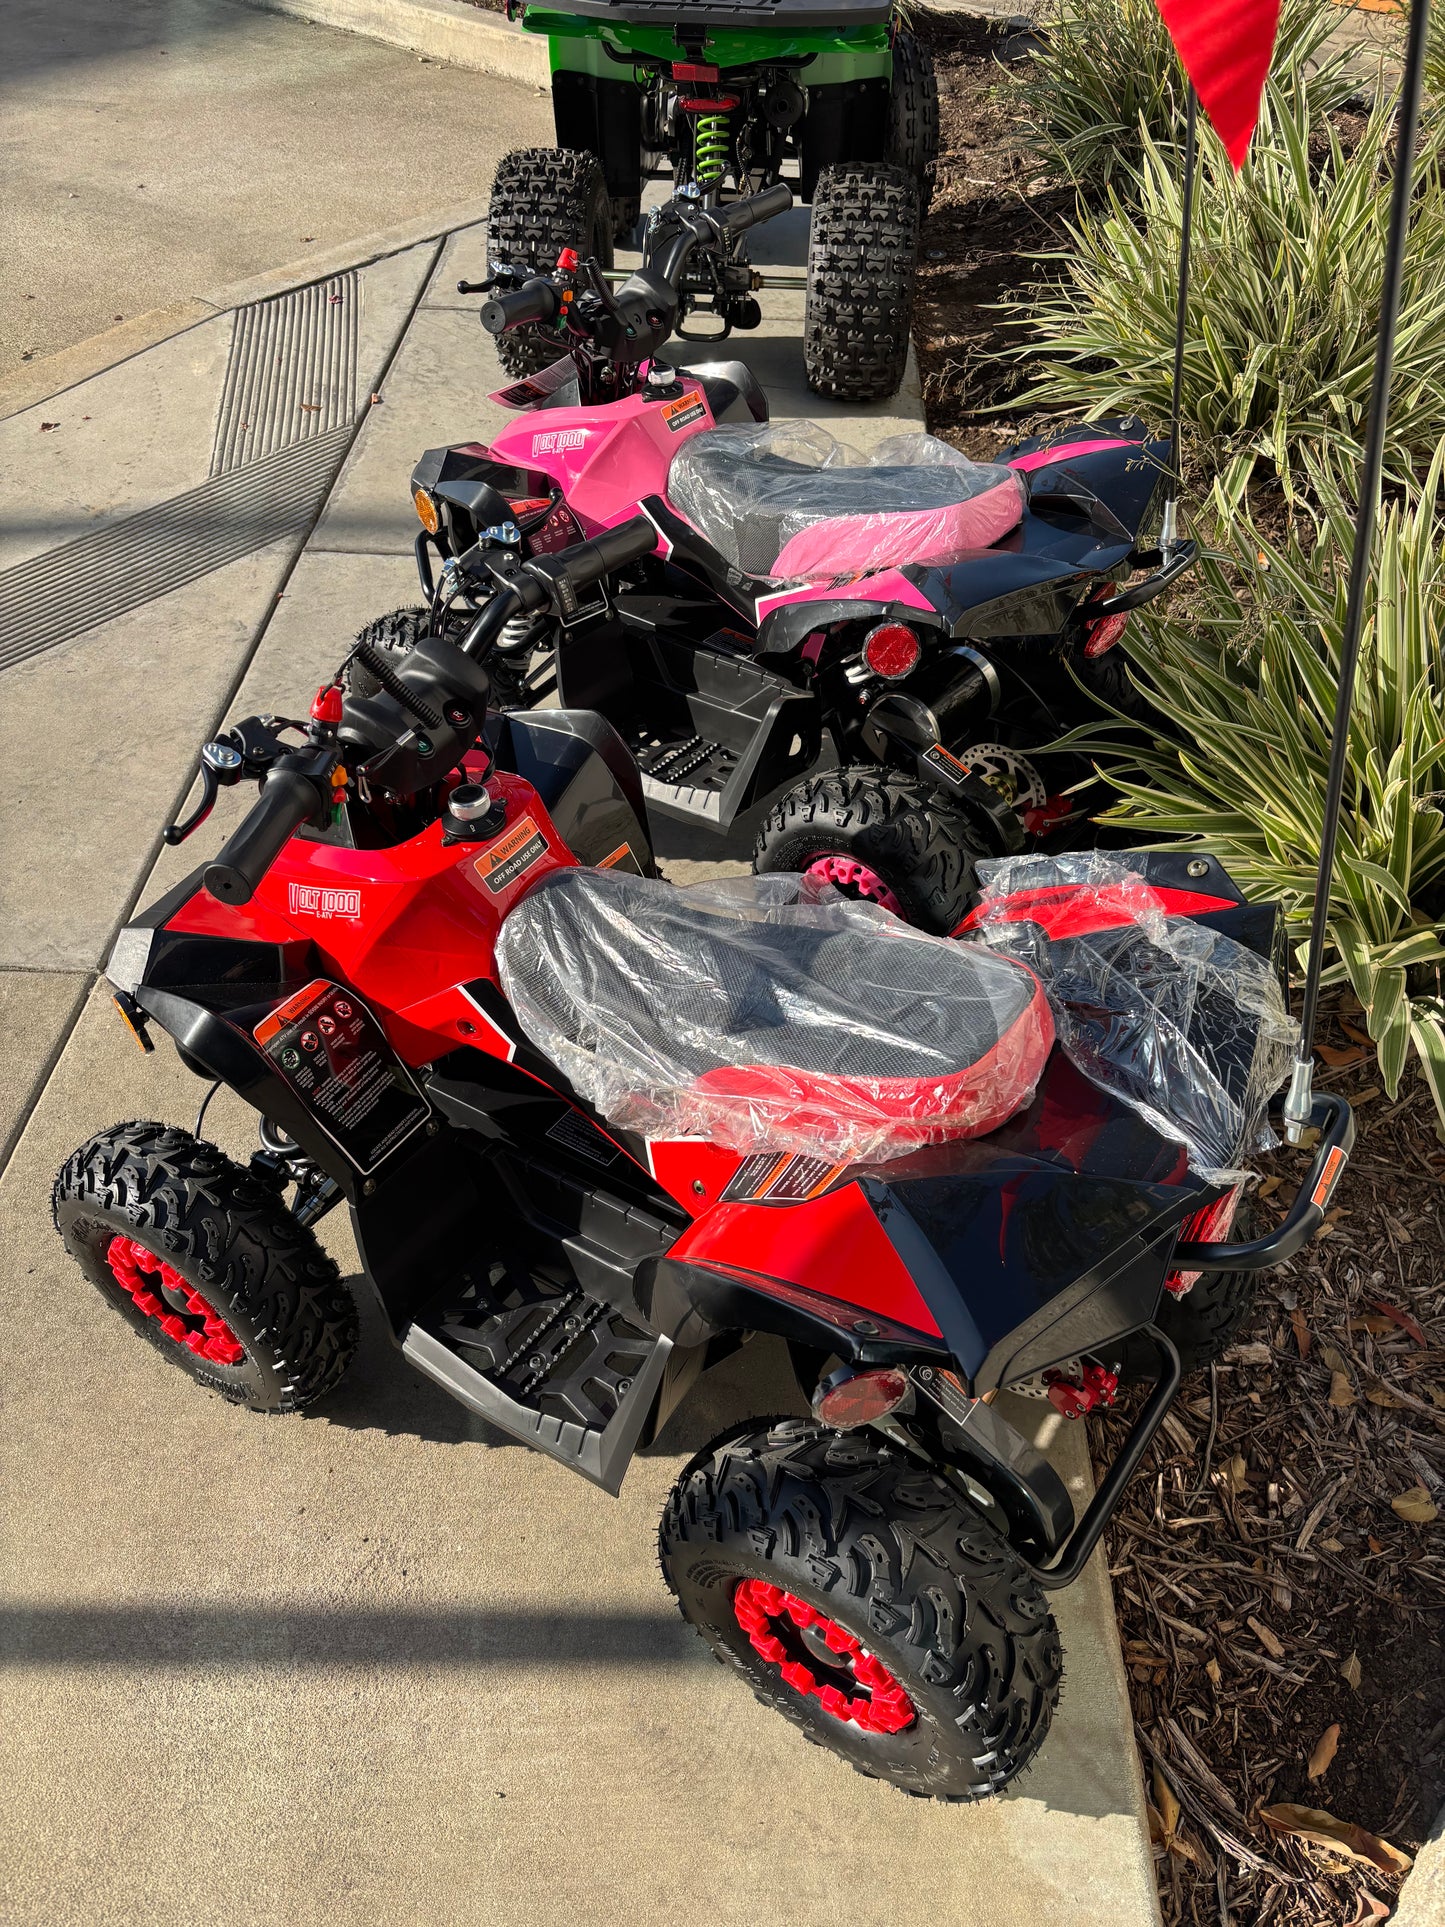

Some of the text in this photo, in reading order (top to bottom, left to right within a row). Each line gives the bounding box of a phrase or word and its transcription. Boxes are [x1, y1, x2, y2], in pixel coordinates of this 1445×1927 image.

[672, 419, 680, 427] OFF
[680, 413, 690, 423] ROAD
[532, 432, 582, 458] VOLT 1000
[500, 826, 531, 855] WARNING
[493, 839, 543, 884] OFF ROAD USE ONLY
[288, 882, 358, 915] VOLT 1000
[316, 911, 333, 919] E-ATV
[288, 995, 311, 1014] WARNING
